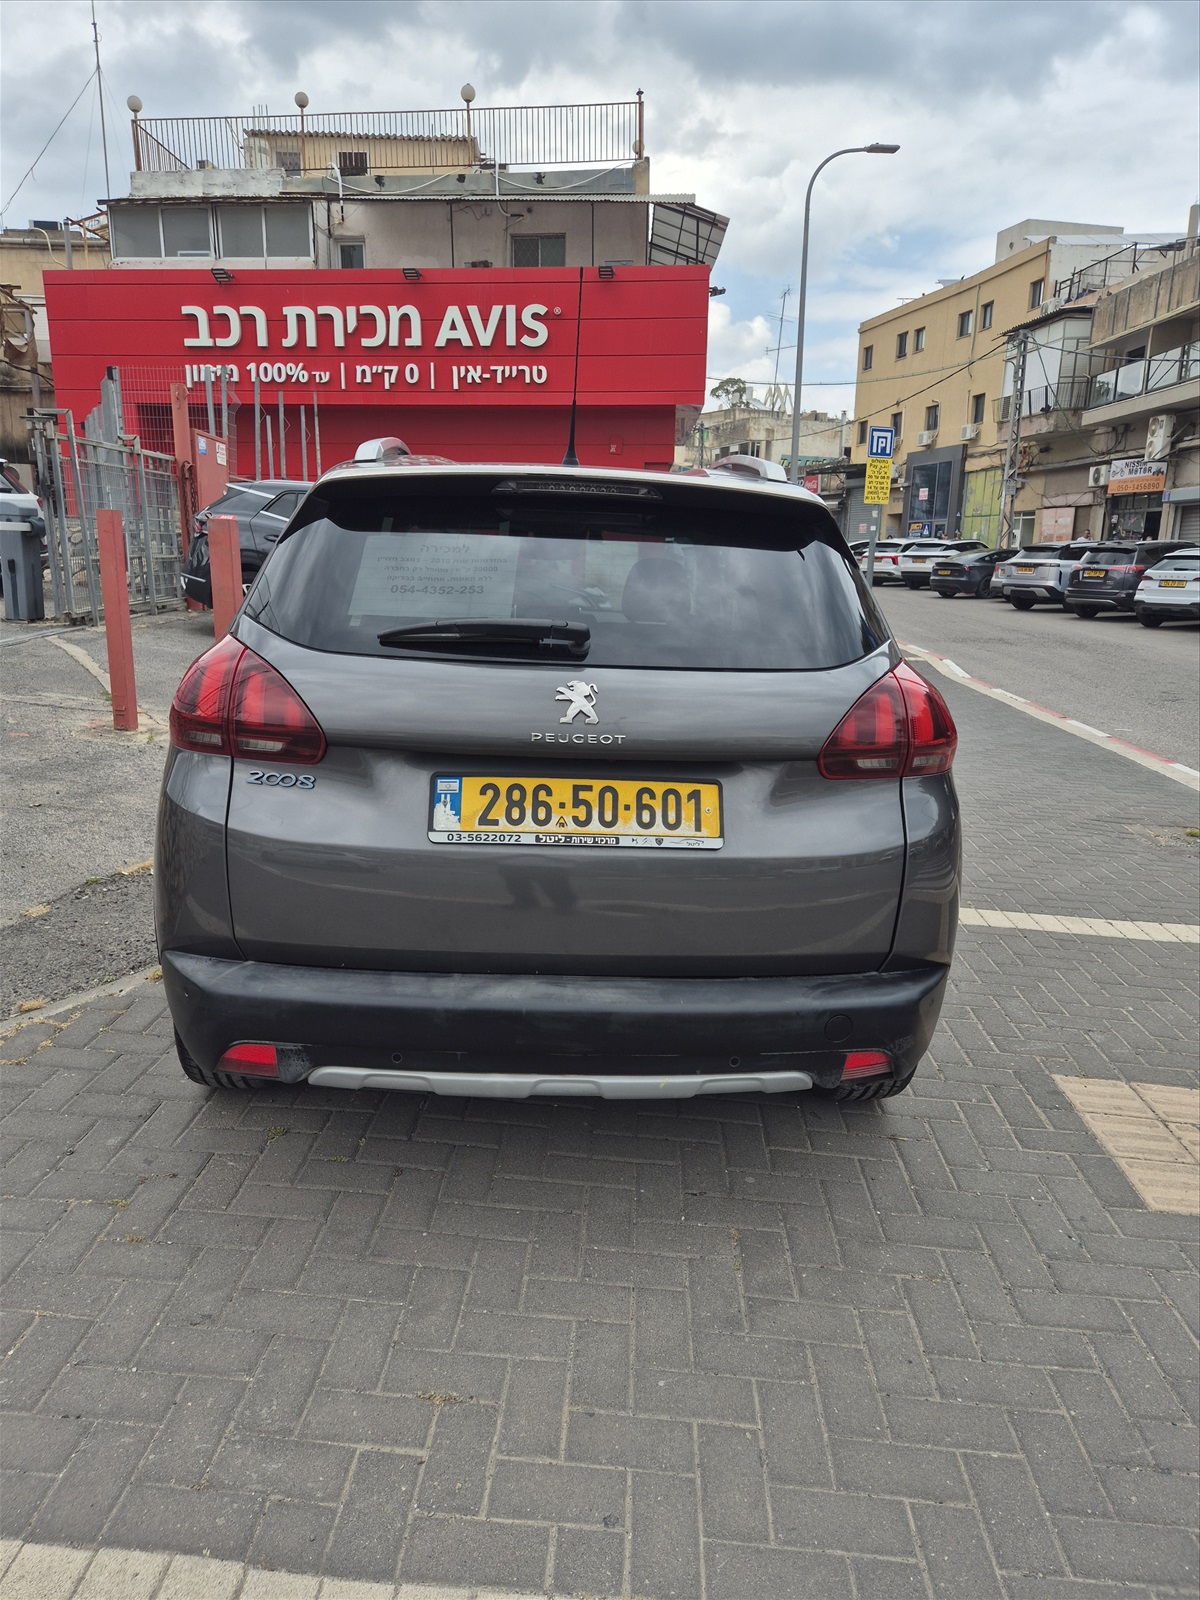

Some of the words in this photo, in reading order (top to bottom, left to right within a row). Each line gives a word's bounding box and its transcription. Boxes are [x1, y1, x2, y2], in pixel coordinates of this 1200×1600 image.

[181, 305, 269, 347] רכב
[282, 304, 423, 348] מכירת
[435, 303, 549, 348] AVIS
[246, 361, 309, 384] 100%
[312, 370, 330, 383] עד
[405, 363, 420, 384] 0
[452, 363, 548, 390] טרייד-אין
[420, 543, 470, 554] למכירה
[390, 585, 485, 595] 054-4352-253
[530, 732, 627, 746] PEUGEOT
[245, 770, 317, 790] 2008
[446, 832, 522, 843] 03-5622072
[595, 836, 616, 845] מרכזי
